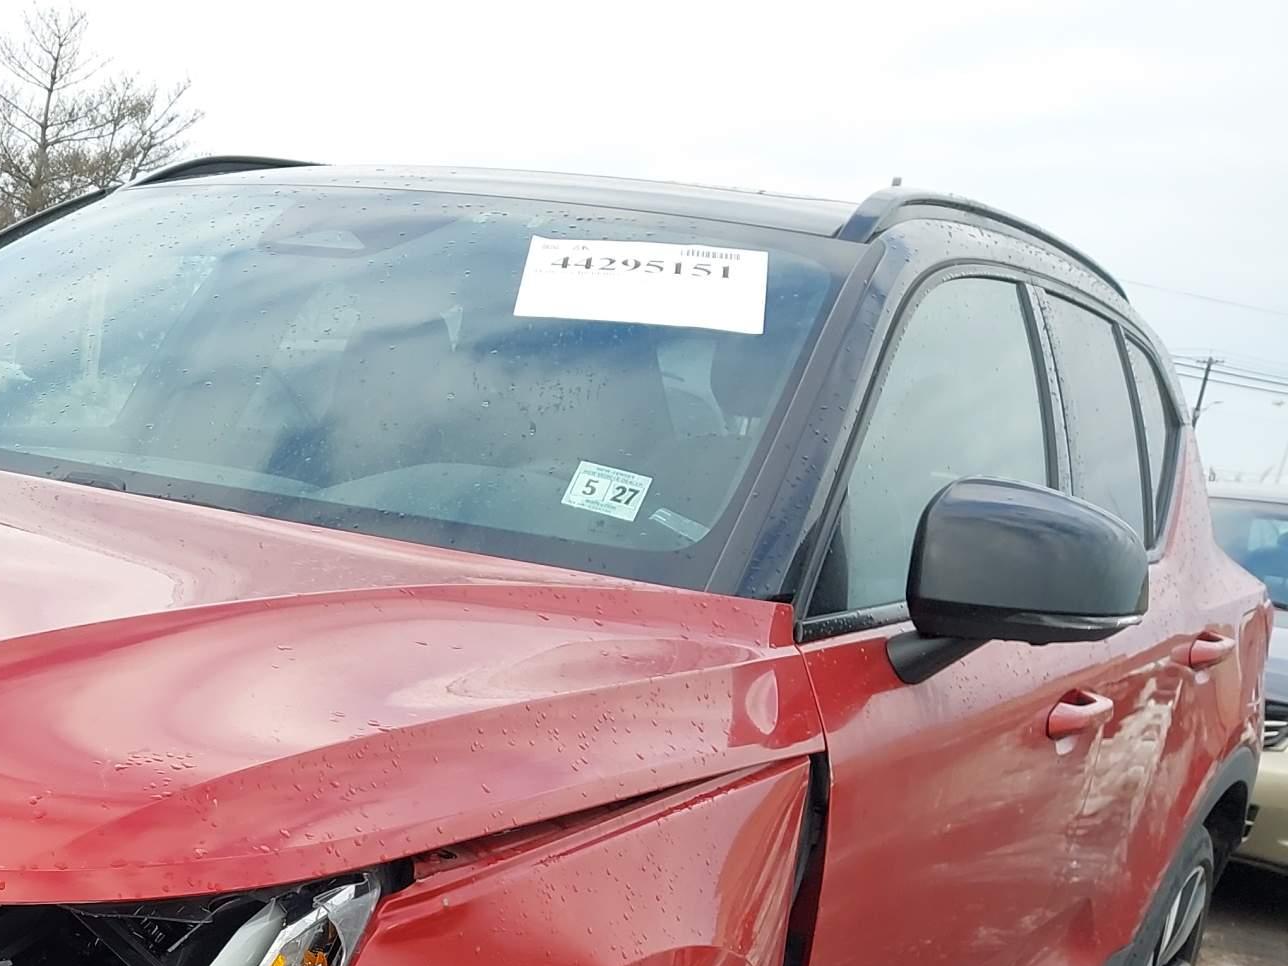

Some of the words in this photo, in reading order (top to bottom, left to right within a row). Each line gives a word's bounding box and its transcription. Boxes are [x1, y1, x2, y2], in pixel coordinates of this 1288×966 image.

[551, 256, 730, 278] 44295151
[582, 479, 599, 495] 5
[611, 486, 640, 505] 27
